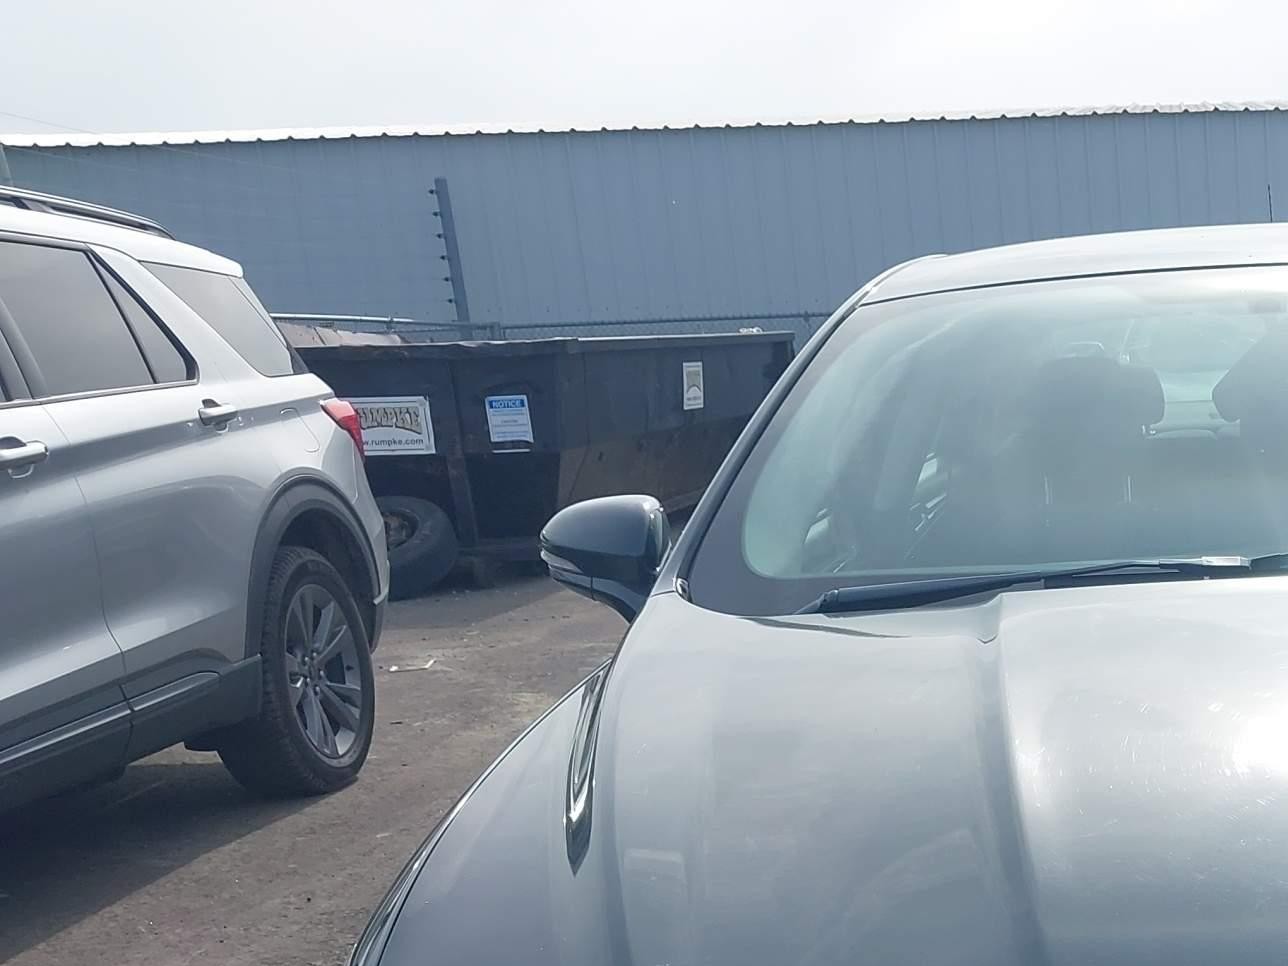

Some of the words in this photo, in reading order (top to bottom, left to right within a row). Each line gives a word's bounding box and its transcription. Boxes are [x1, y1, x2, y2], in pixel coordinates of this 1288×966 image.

[492, 399, 522, 408] NOTICE
[357, 407, 422, 434] UMPKE
[363, 438, 424, 447] w.rumpke.com
